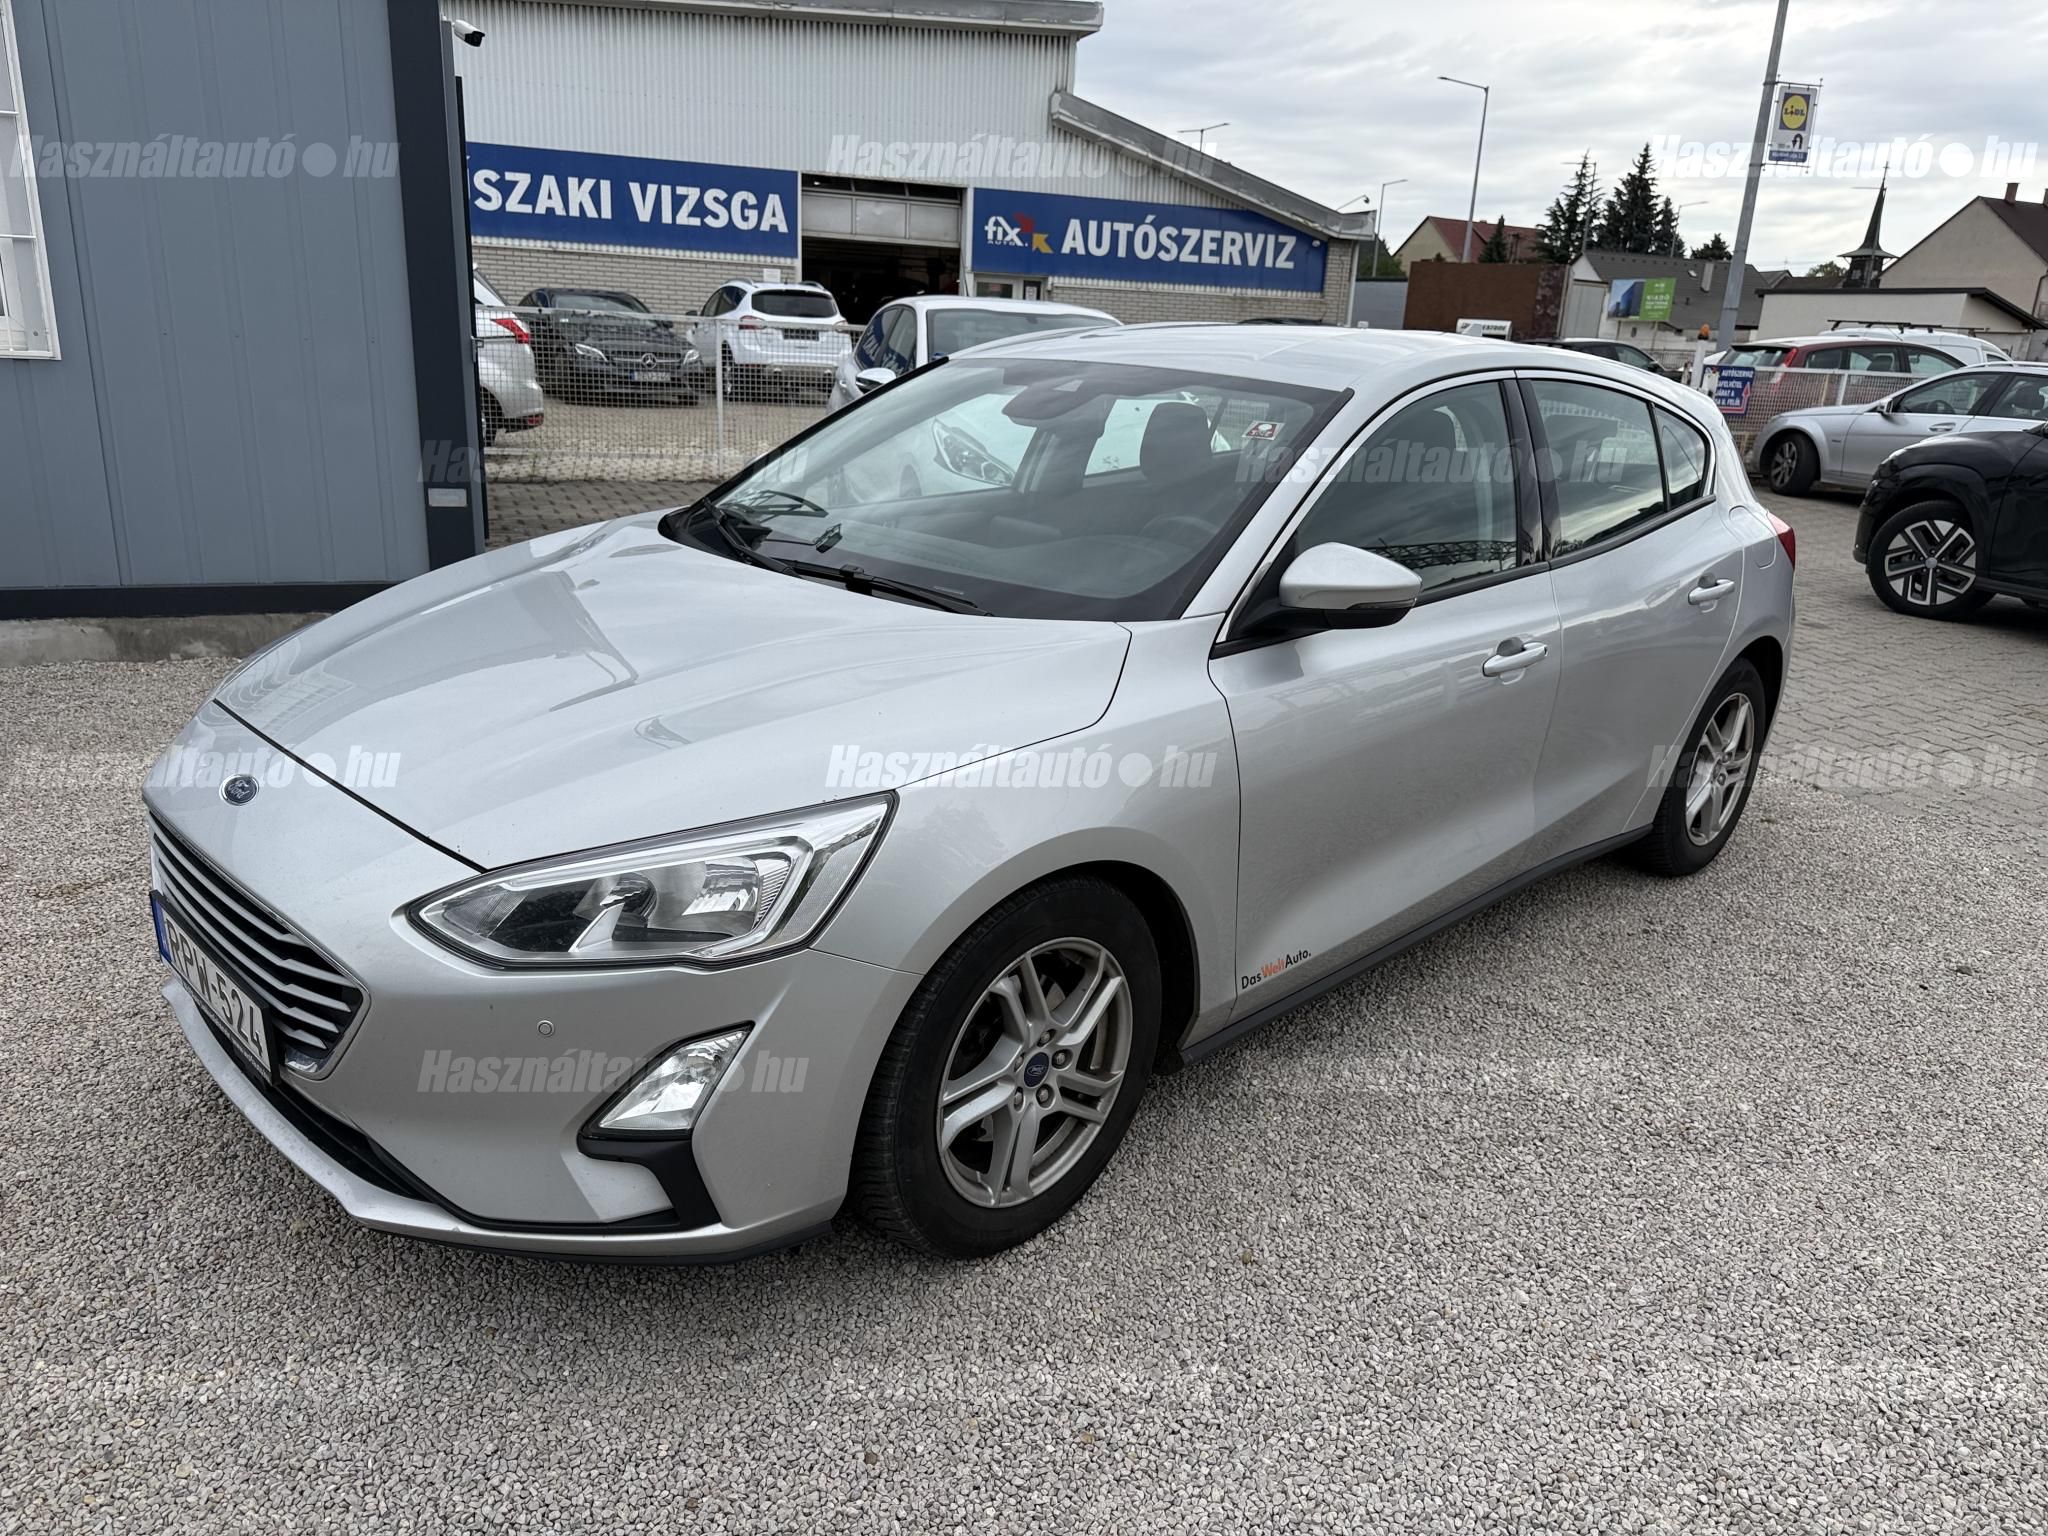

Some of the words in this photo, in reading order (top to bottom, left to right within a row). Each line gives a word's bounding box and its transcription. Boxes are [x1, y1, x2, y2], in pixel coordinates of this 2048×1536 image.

[467, 155, 612, 219] SZAKI
[629, 181, 789, 234] VIZSGA
[1061, 214, 1297, 270] AUTÓSZERVIZ
[166, 917, 264, 1059] RPW-524
